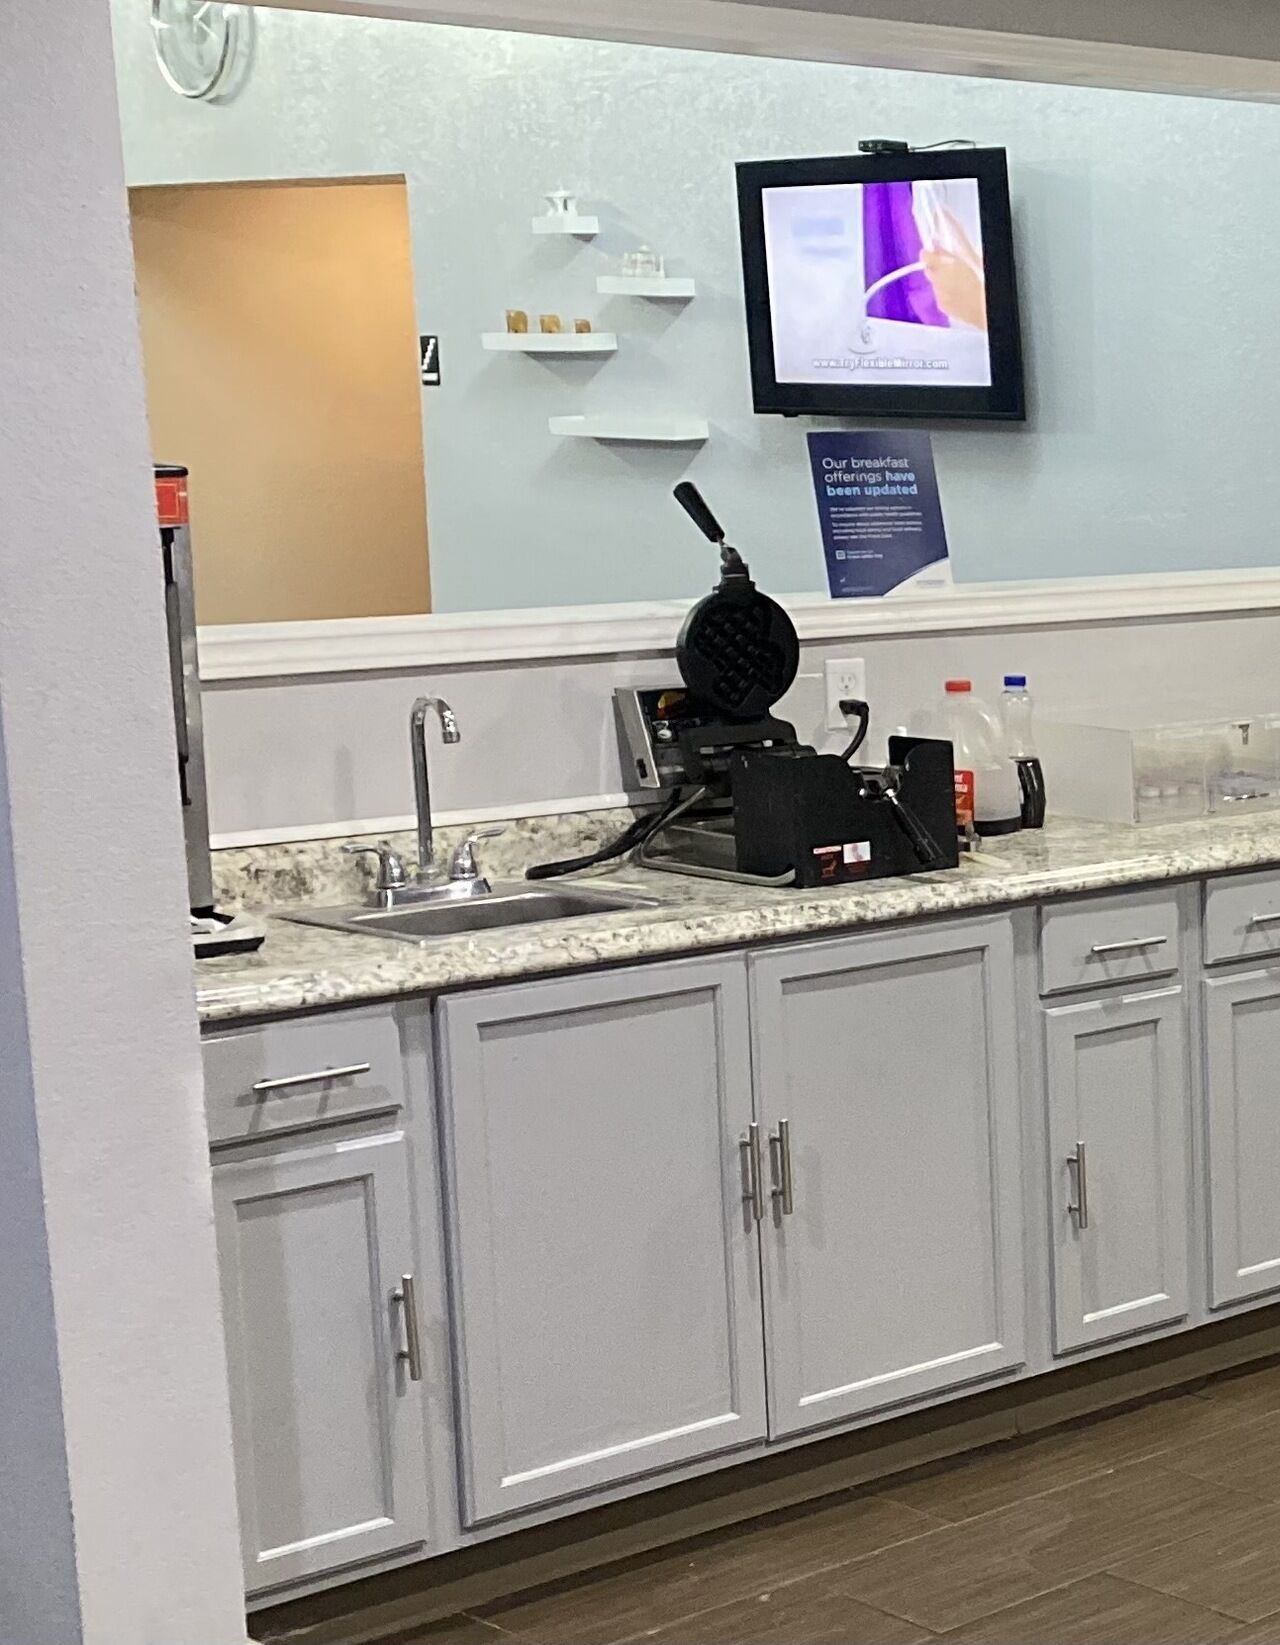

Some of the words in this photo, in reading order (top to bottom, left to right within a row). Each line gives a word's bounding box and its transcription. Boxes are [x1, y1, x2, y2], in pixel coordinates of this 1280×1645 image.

[822, 457, 848, 470] Our
[851, 457, 910, 469] breakfast
[824, 470, 882, 484] offerings
[885, 470, 915, 483] have
[827, 484, 860, 497] been
[864, 484, 918, 498] updated
